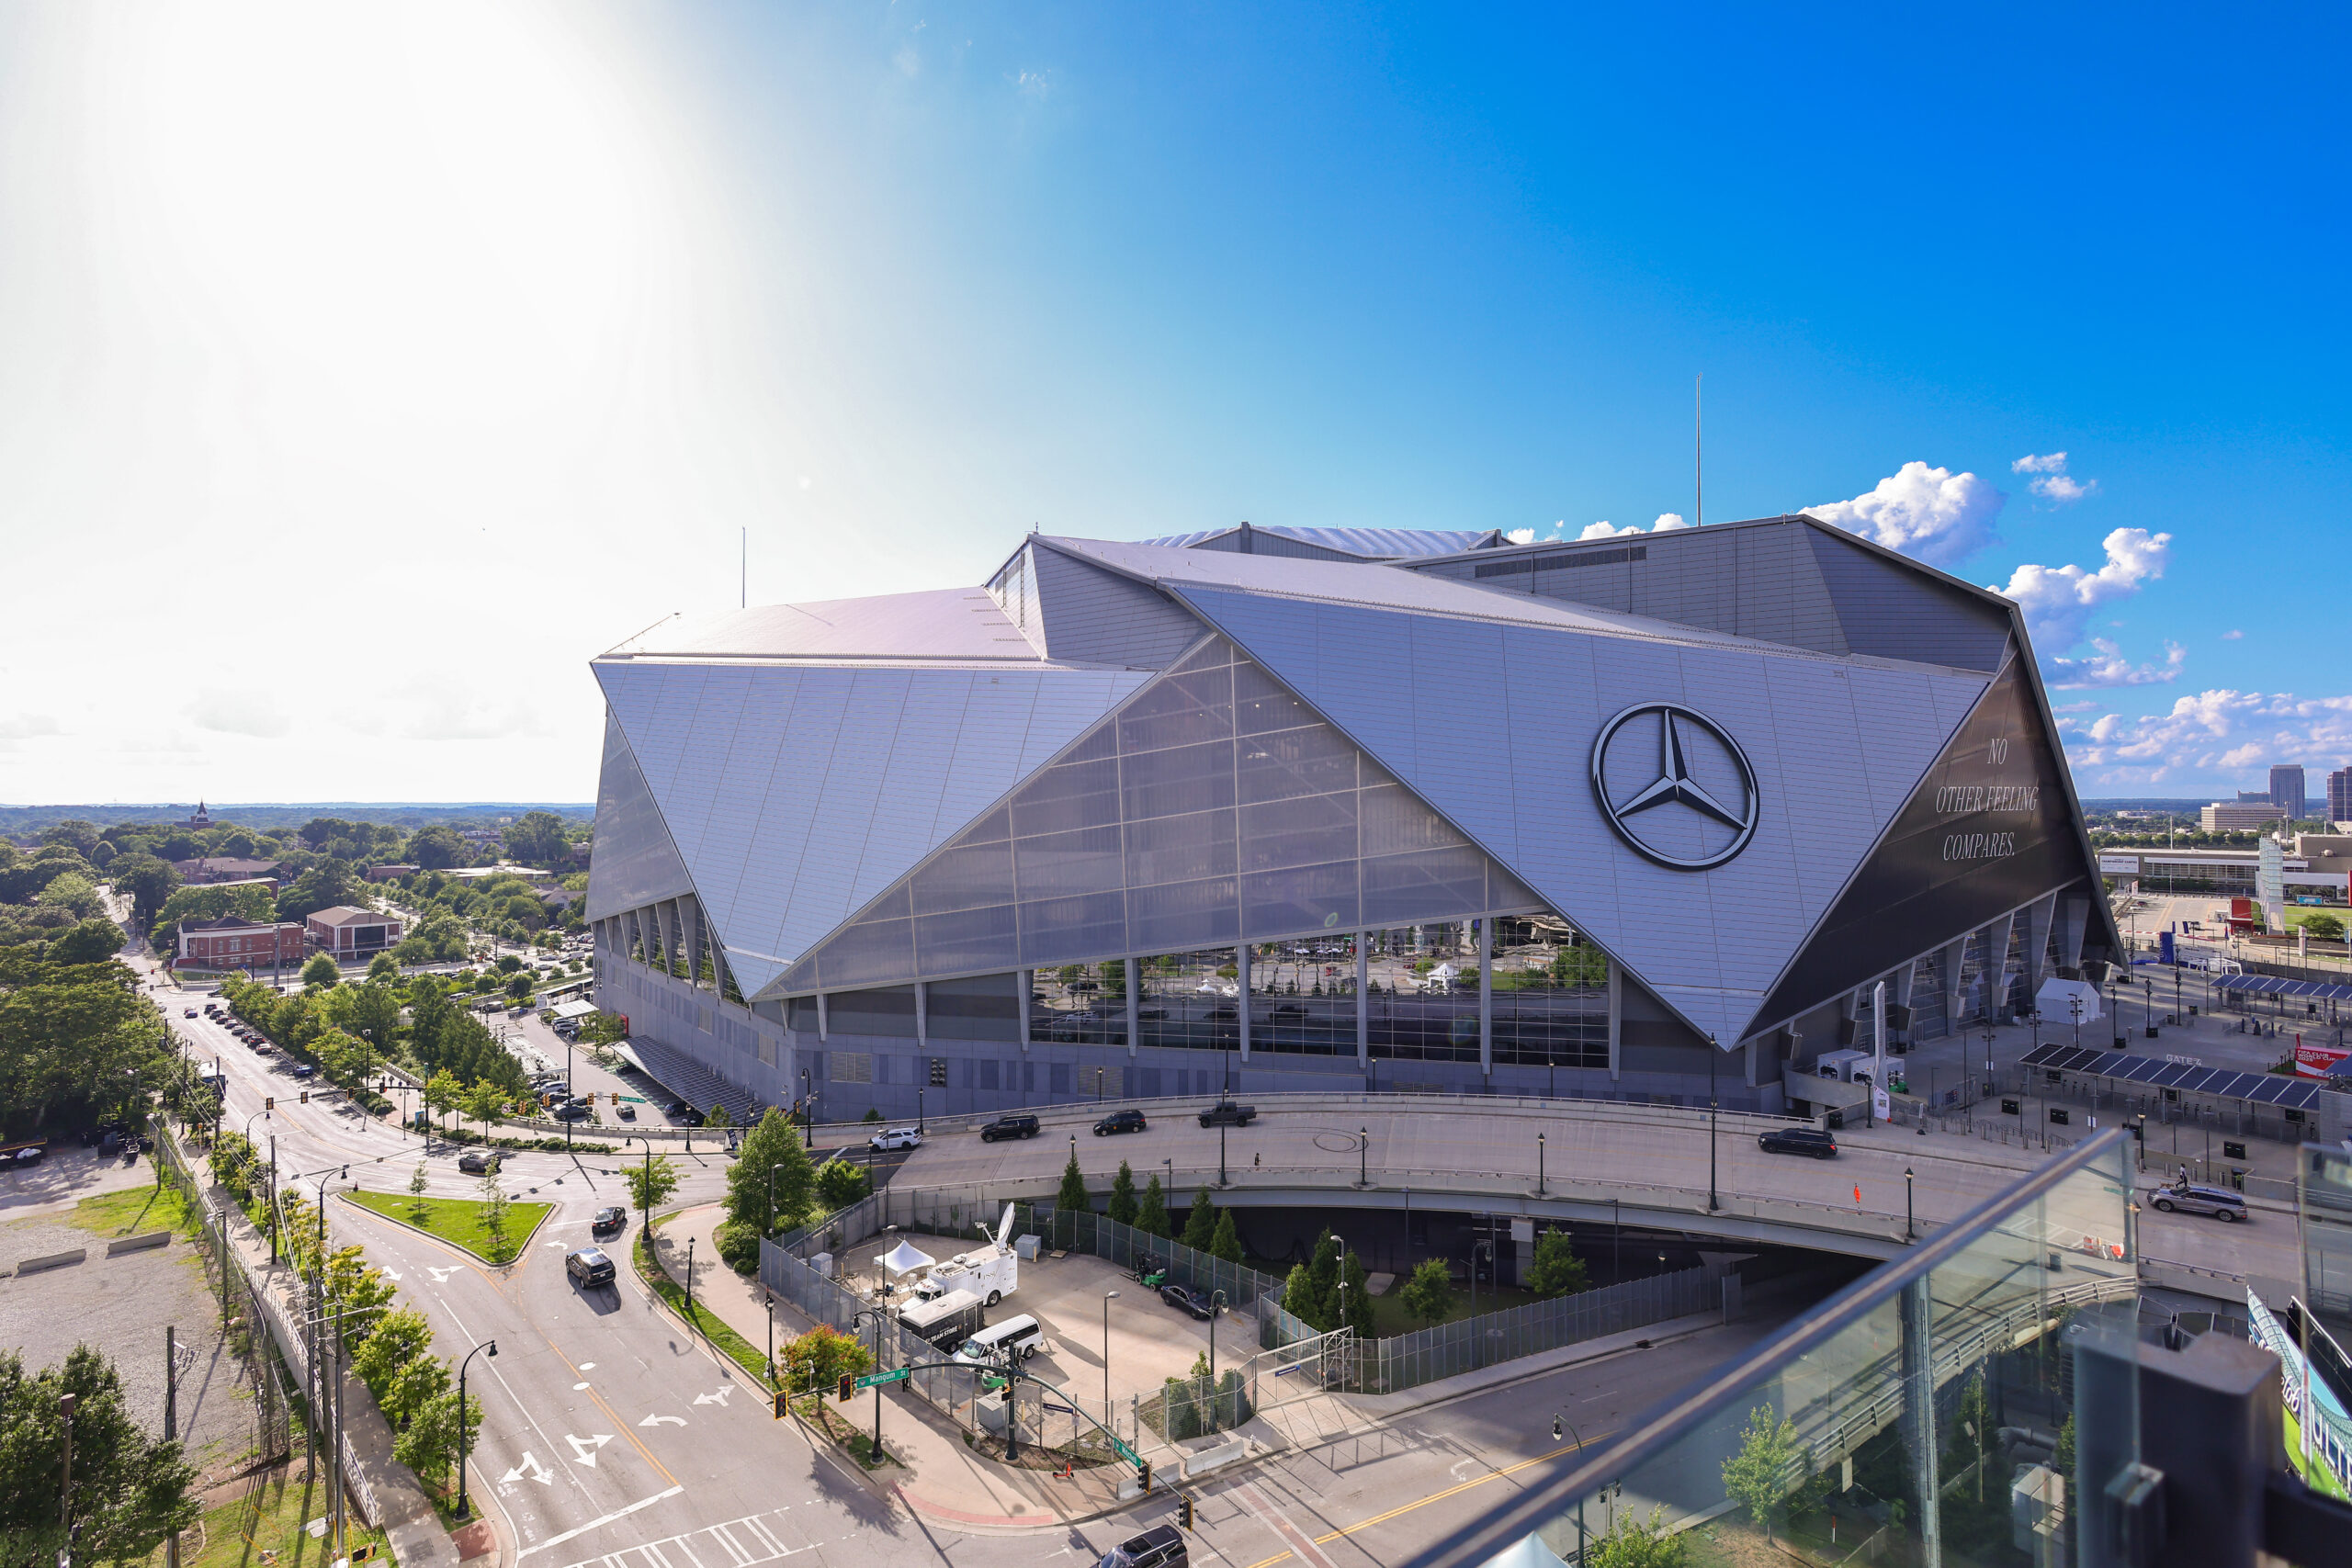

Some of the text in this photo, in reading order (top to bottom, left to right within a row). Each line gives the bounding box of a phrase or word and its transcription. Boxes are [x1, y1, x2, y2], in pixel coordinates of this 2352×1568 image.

[1986, 739, 2007, 764] NO
[1936, 786, 2039, 813] OTHER FEELING
[1943, 832, 2015, 861] COMPARES.
[2166, 1054, 2193, 1066] GATE
[931, 1332, 944, 1343] TEAM
[944, 1325, 957, 1337] STORE
[870, 1372, 896, 1383] Mangum
